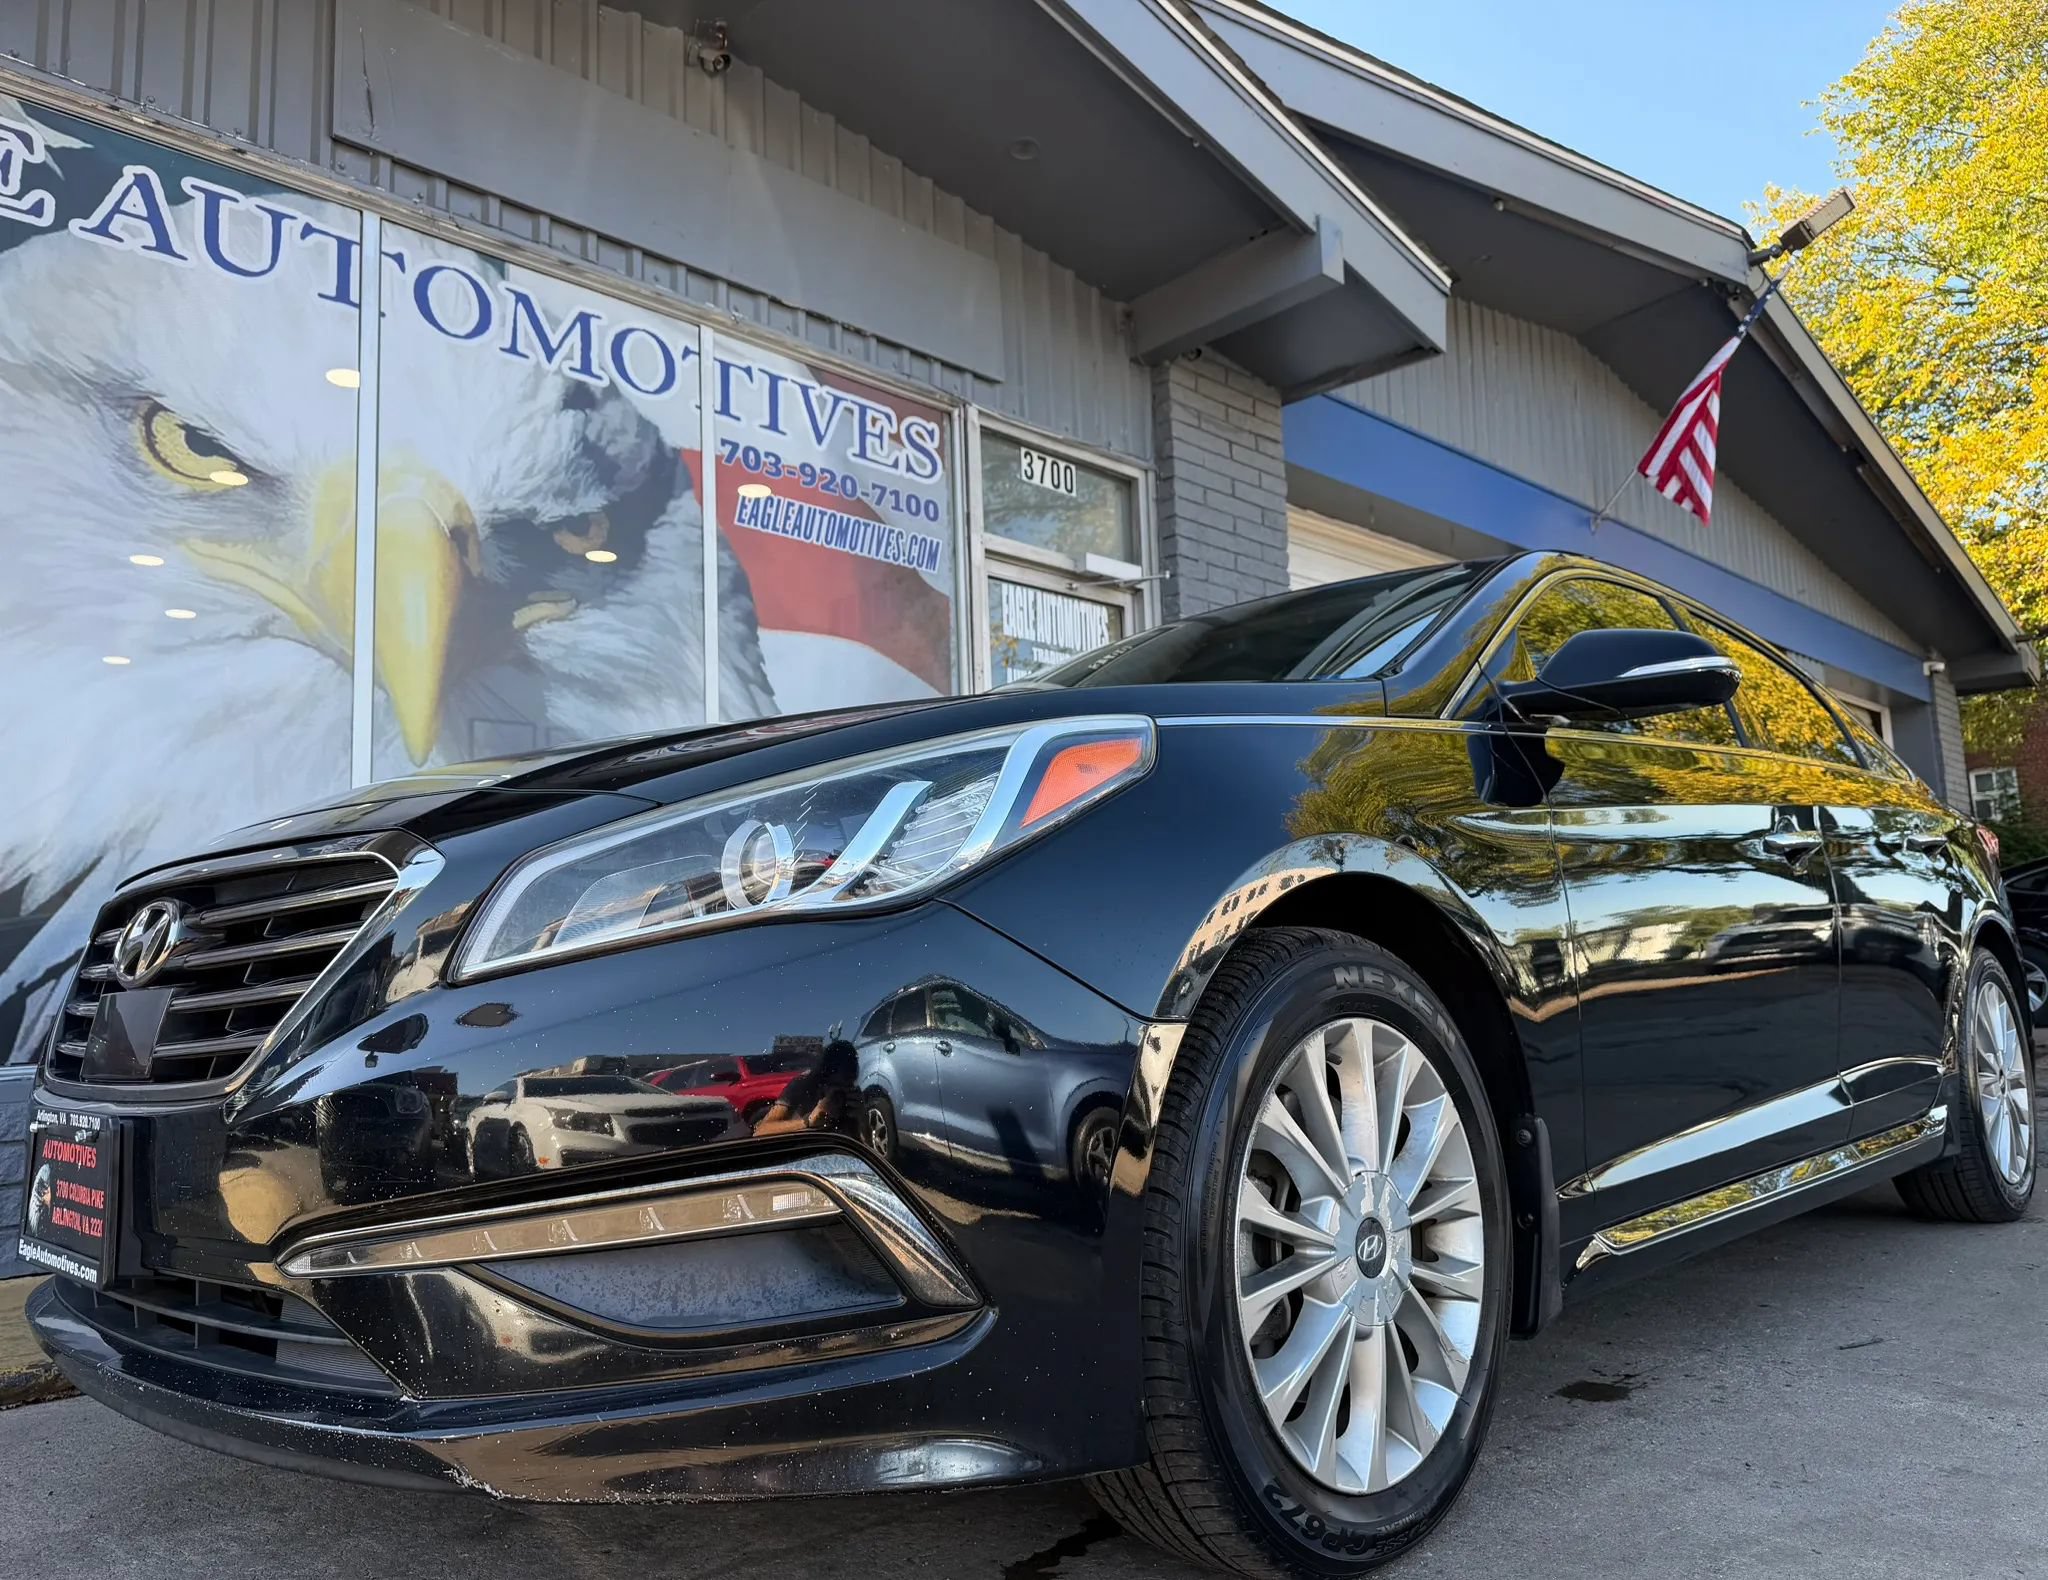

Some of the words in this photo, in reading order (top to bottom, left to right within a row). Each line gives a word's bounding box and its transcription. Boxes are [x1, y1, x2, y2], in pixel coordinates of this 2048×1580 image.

[76, 170, 939, 481] AUTOMOTIVES
[719, 437, 940, 522] 703-920-7100
[1024, 450, 1074, 494] 3700
[735, 493, 942, 572] EAGLEAUTOMOTIVES.COM
[1001, 582, 1037, 642] EAGLE
[1036, 590, 1110, 652] AUTOMOTIVES
[1333, 965, 1457, 1048] NEXEN
[36, 1109, 59, 1126] Arlington,
[59, 1111, 67, 1125] VA
[42, 1138, 97, 1169] AUTOMOTIVES
[91, 1187, 105, 1209] PIKE
[18, 1238, 98, 1284] EagleAutomotives.com
